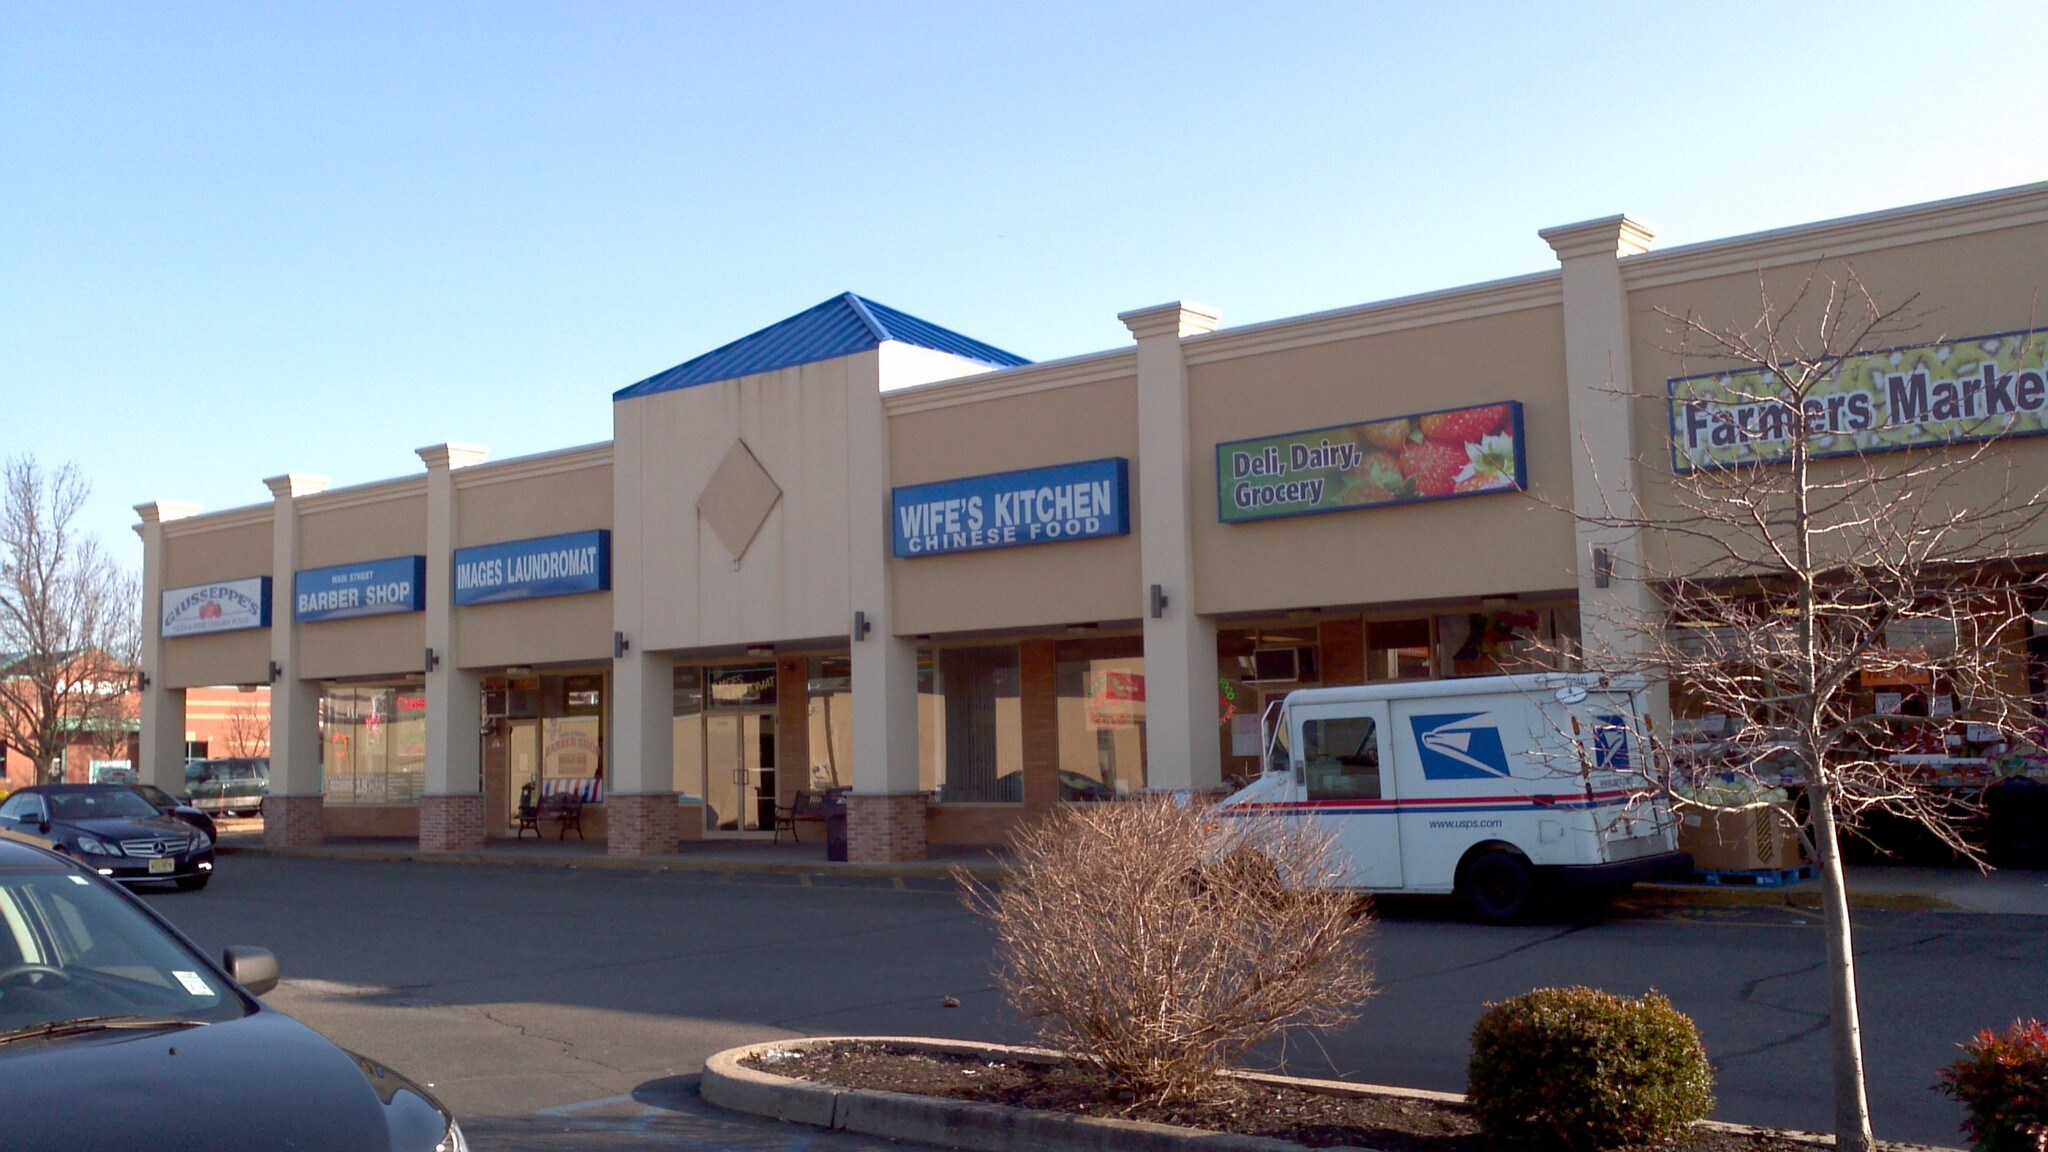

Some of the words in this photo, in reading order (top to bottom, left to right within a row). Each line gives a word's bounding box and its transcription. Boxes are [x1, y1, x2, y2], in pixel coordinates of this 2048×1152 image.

[1685, 391, 1872, 449] Farmers
[1888, 364, 2048, 425] Marke
[1233, 446, 1287, 479] Deli,
[1290, 438, 1362, 472] Dairy,
[900, 495, 984, 538] WIFE'S
[994, 479, 1111, 527] KITCHEN
[1234, 478, 1324, 509] Grocery
[908, 526, 1017, 552] CHINESE
[1030, 517, 1100, 540] FOOD
[331, 574, 347, 584] MAIN
[349, 570, 374, 582] STREET
[457, 558, 503, 589] IMAGES
[507, 546, 597, 583] LAUNDROMAT
[298, 588, 359, 613] BARBER
[365, 581, 410, 605] SHOP
[1429, 819, 1503, 831] www.usps.com
